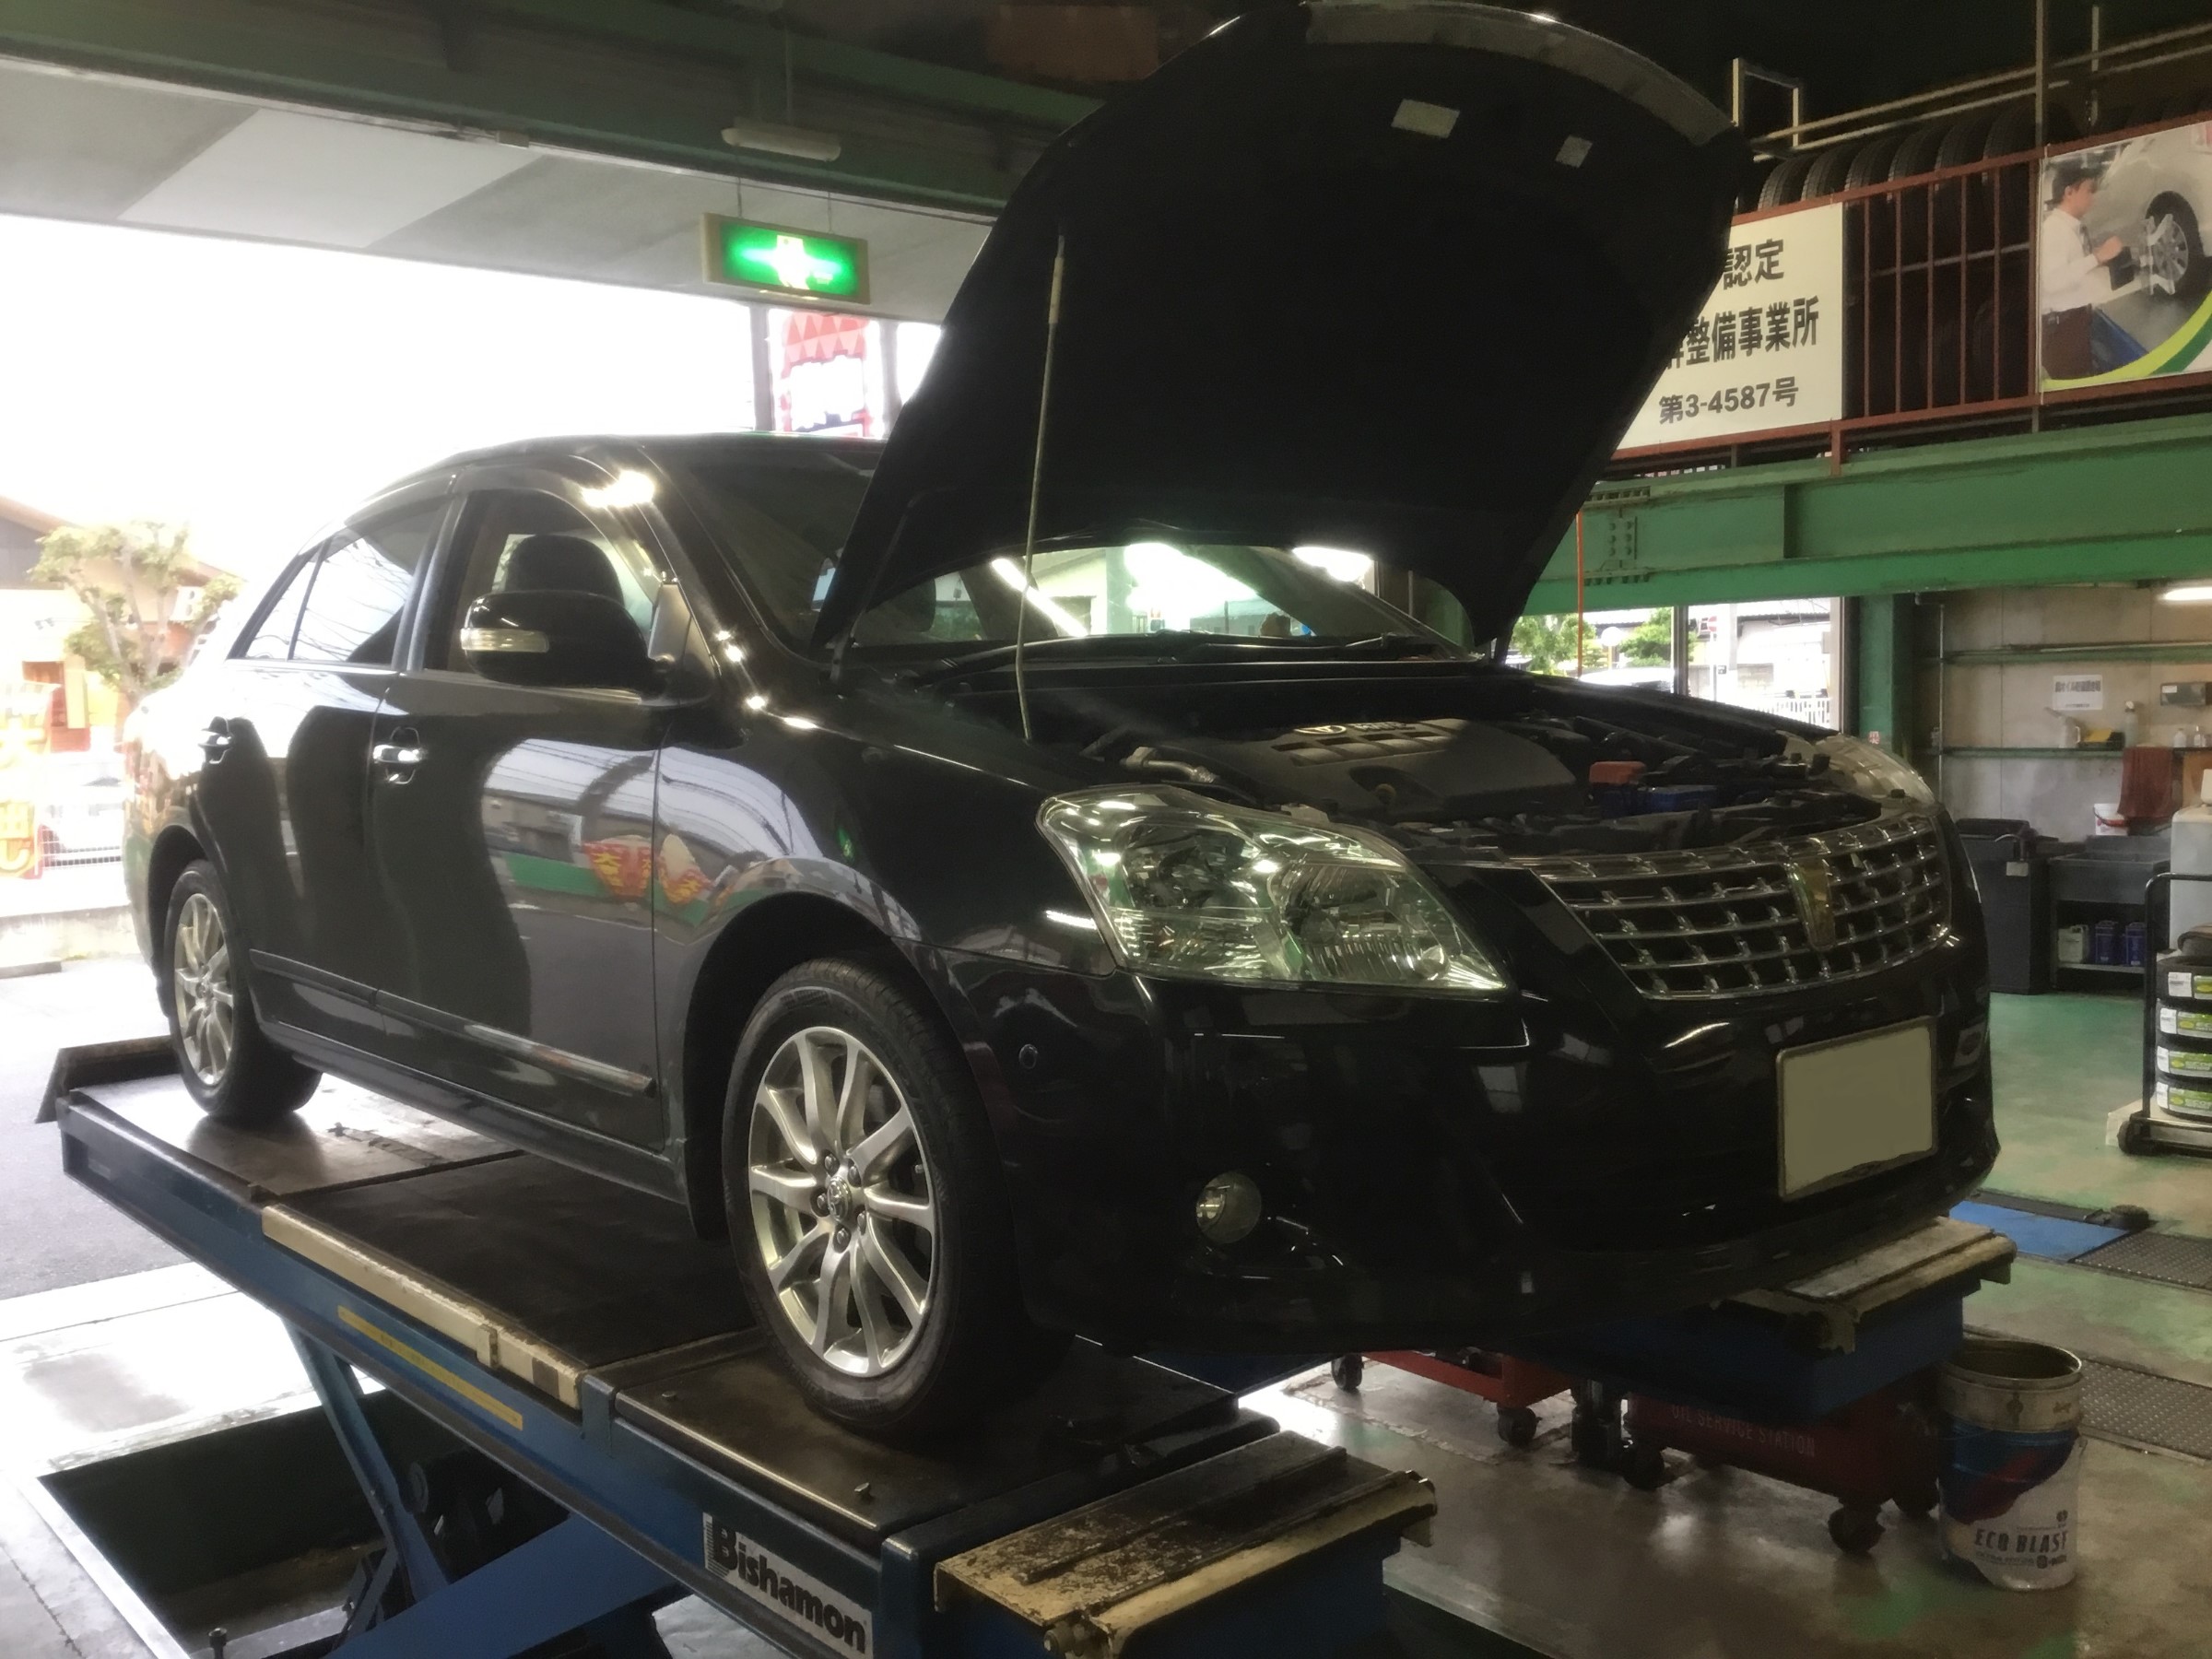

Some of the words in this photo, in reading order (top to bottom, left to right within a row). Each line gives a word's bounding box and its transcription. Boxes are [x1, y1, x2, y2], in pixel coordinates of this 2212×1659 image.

[1659, 376, 1800, 425] 第3-4587号
[1697, 1408, 1754, 1440] SERVICE
[1759, 1428, 1816, 1458] STATION
[1974, 1528, 2010, 1552] ECO
[2016, 1530, 2068, 1553] BLAST
[710, 1517, 866, 1654] Bishamon
